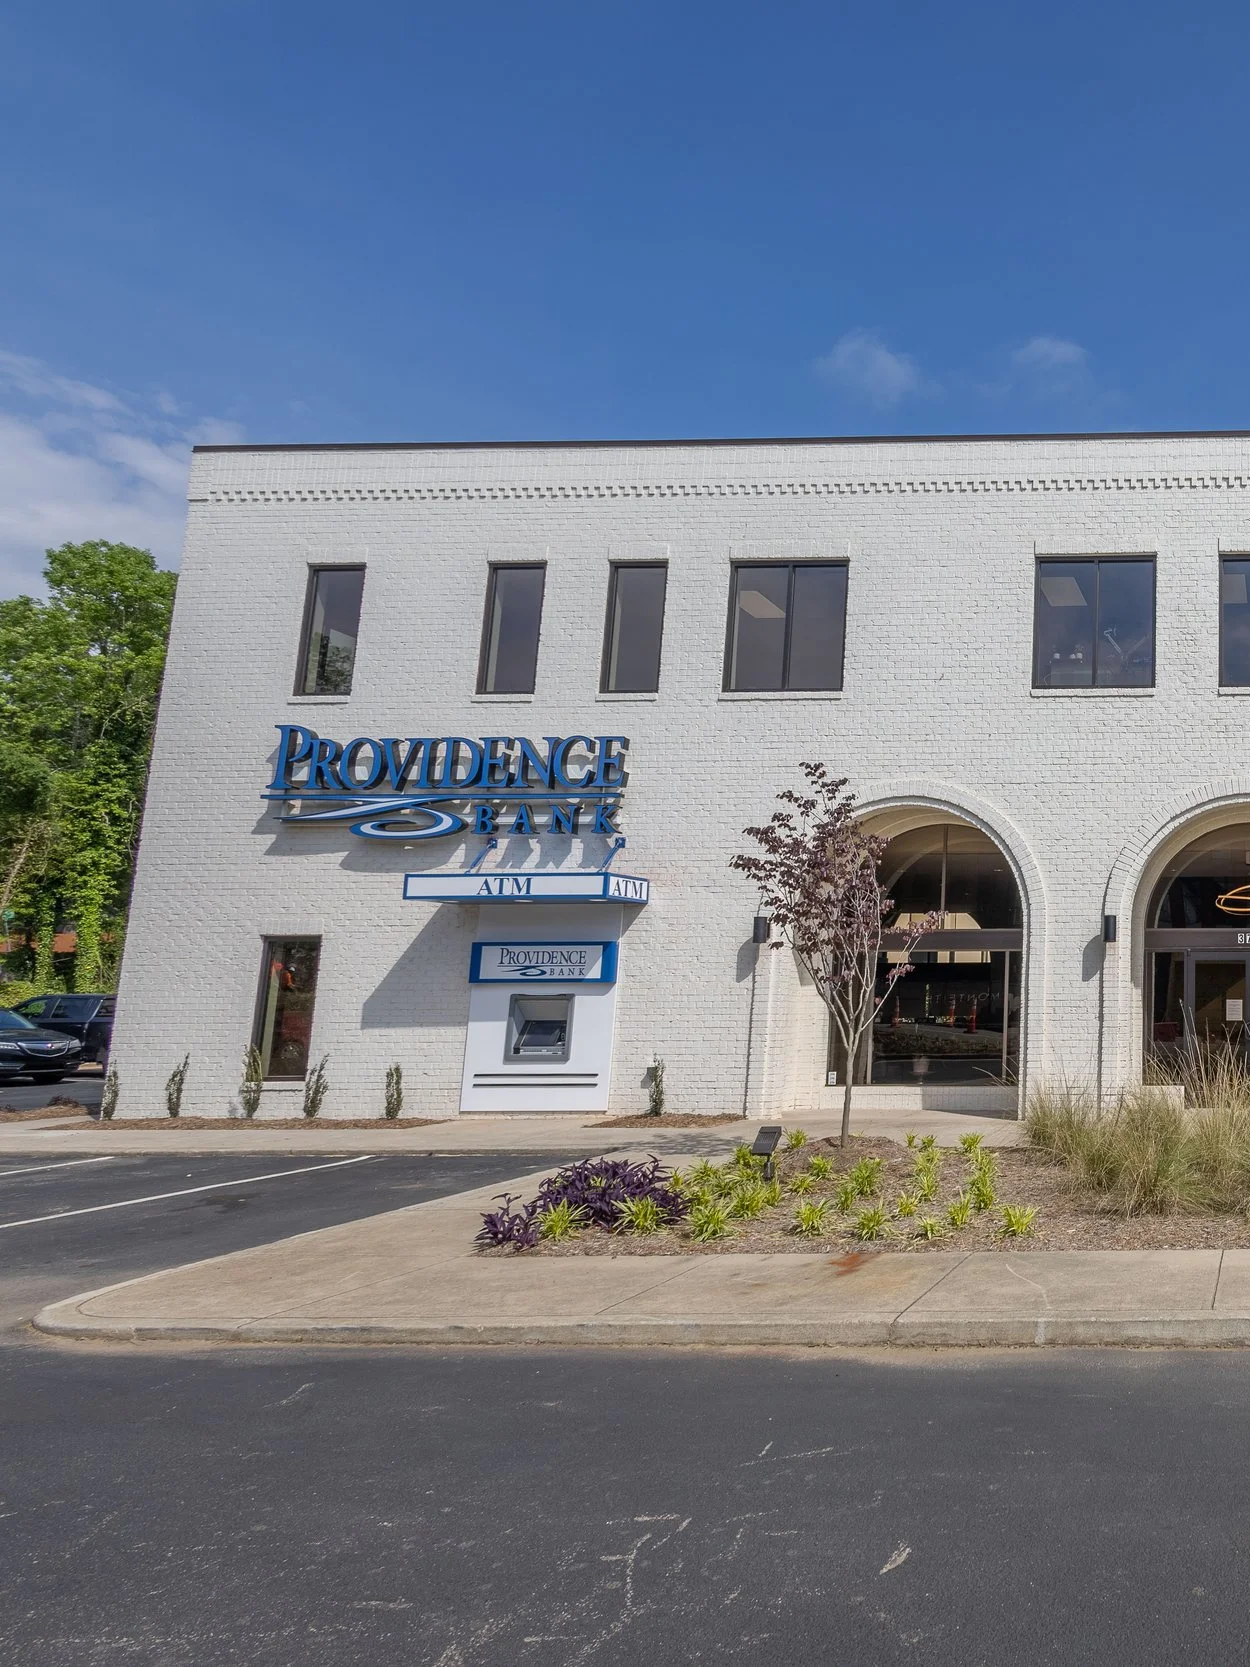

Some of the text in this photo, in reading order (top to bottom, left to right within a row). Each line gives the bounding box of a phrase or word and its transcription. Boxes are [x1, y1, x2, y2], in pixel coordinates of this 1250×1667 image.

[266, 724, 631, 791] PROVIDENCE
[473, 804, 623, 836] BANK
[477, 877, 533, 895] ATM
[612, 879, 643, 898] ATM
[498, 947, 587, 964] PROVIDENCE
[549, 967, 585, 976] BANK
